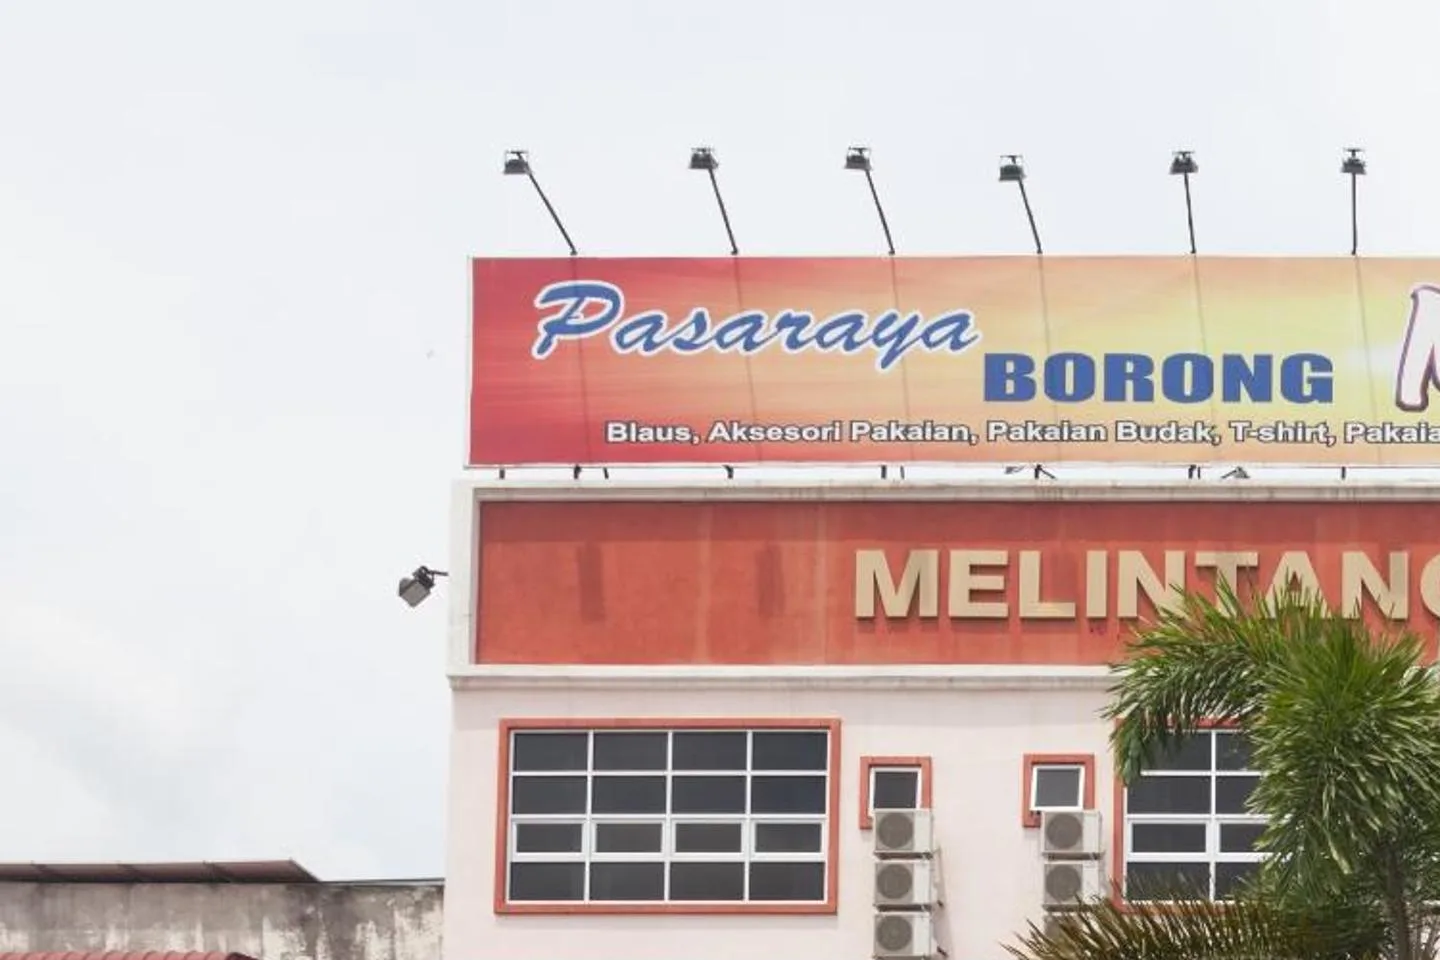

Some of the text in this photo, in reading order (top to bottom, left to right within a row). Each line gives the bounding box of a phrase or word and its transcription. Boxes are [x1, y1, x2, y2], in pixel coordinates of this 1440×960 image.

[533, 281, 981, 374] Pasaraya
[983, 352, 1334, 403] BORONG
[606, 421, 700, 445] Blaus,
[707, 420, 841, 443] Aksesori
[850, 420, 978, 446] Pakaian,
[986, 421, 1109, 444] Pakaian
[1115, 421, 1222, 447] Budak,
[1229, 421, 1337, 447] T-shirt,
